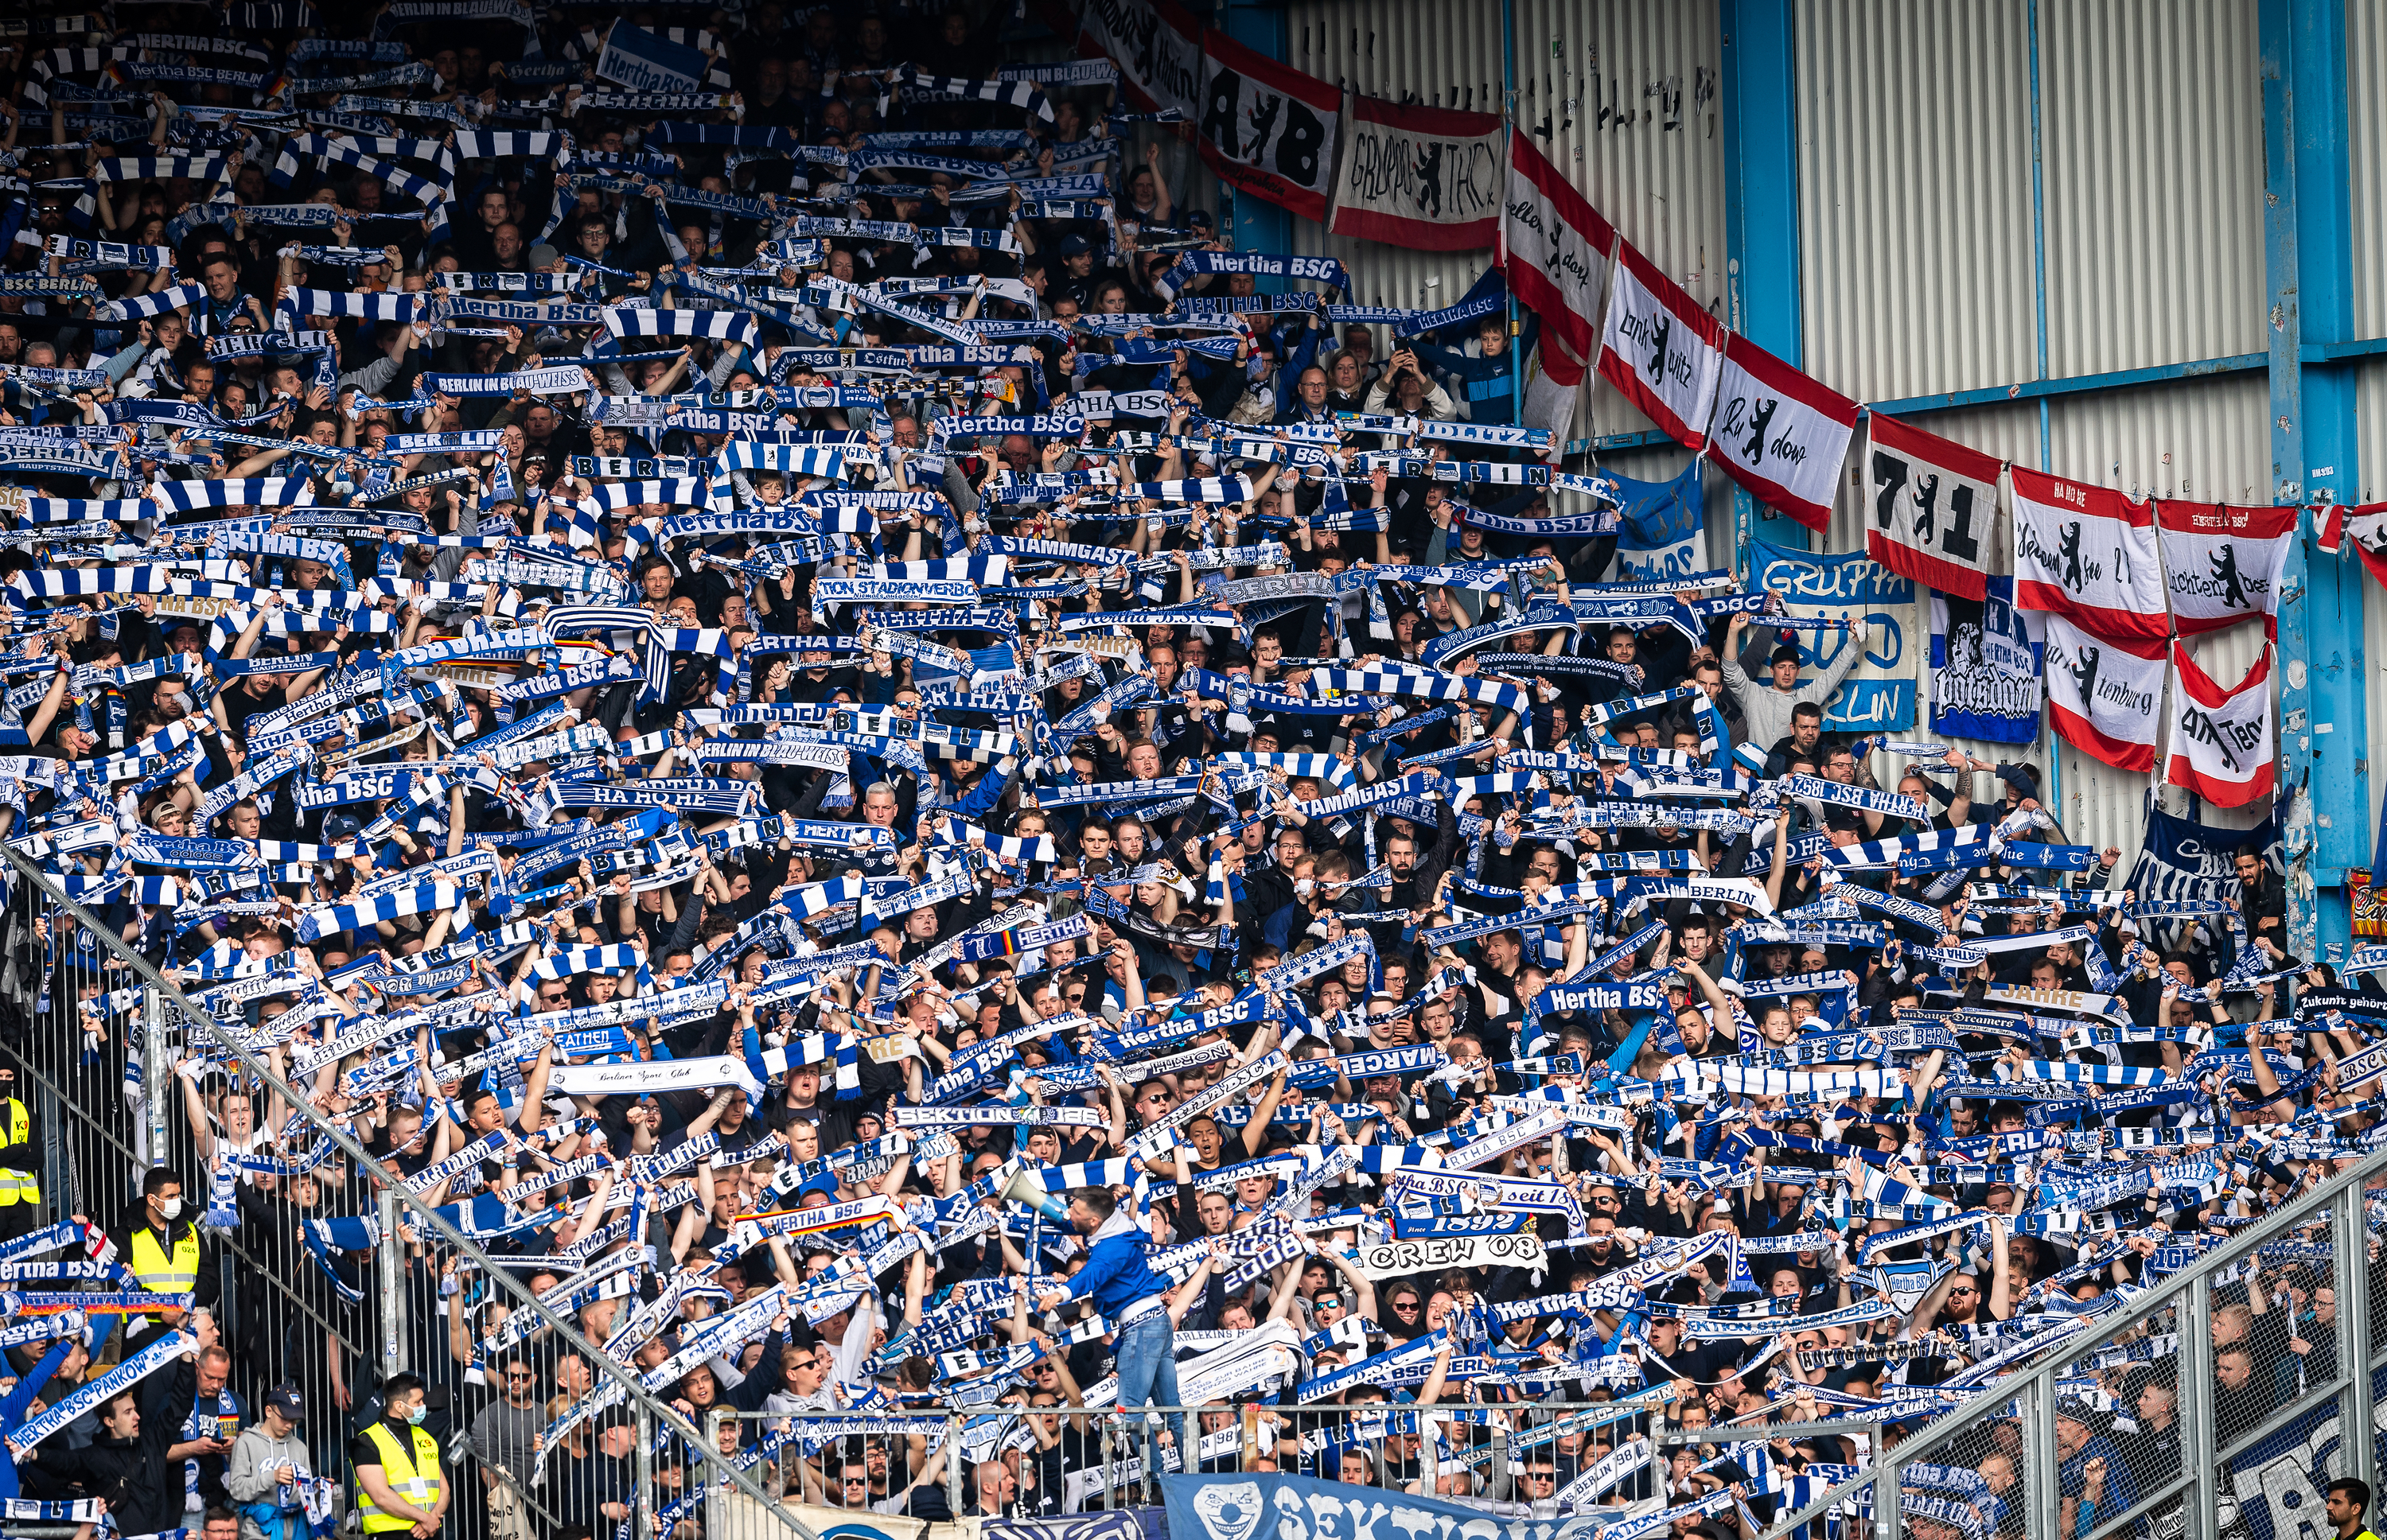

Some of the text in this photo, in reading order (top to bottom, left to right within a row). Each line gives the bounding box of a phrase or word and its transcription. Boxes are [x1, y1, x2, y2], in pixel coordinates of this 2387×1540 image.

[137, 33, 247, 56] HERTHA BSC
[131, 61, 264, 85] Hertha BSC BERLIN
[604, 93, 715, 110] STEGLITZ
[1209, 254, 1335, 279] Hertha BSC
[5, 278, 98, 292] BSC BERLIN
[450, 296, 601, 321] Hertha BSC
[1177, 292, 1318, 314] HERTHA BSC
[1419, 298, 1494, 329] HERTHA BSC
[899, 304, 980, 345] AUS BERLIN
[964, 344, 1008, 363] BSC
[1668, 348, 1692, 389] witz
[438, 370, 579, 392] BERLIN IN BLAU-WEISS
[76, 426, 130, 441] BERLIN
[727, 413, 769, 431] BSC
[944, 416, 1084, 435] Hertha BSC
[18, 463, 81, 472] HAUPTSTADT
[2054, 482, 2085, 508] HA HO HE
[386, 513, 422, 530] Berlin
[300, 538, 346, 568] BSC
[1003, 535, 1137, 569] STAMMGAST
[512, 561, 574, 584] WIEDER
[1445, 567, 1497, 585] BSC
[1762, 559, 1906, 597] GRUPPA
[192, 597, 232, 617] BSC
[1080, 610, 1215, 626] Hertha B.S.C.
[1641, 601, 1667, 614] SÜD
[1436, 604, 1556, 651] GRUPPA SÜD
[1986, 641, 2030, 674] HERTHA BSC
[425, 663, 498, 686] JAHRE
[495, 659, 605, 702] Hertha BSC
[286, 683, 365, 725] Hertha BSC
[299, 717, 338, 741] BSC
[697, 741, 845, 766] BERLIN IN BLAU-WEISS
[345, 774, 394, 799] BSC
[594, 788, 708, 807] HA HO HE
[1057, 777, 1169, 798] BERLIN
[1794, 774, 1827, 797] 1892
[1831, 781, 1865, 804] BSC
[135, 835, 216, 853] Hertha
[475, 830, 504, 846] Hause
[533, 826, 547, 838] wir
[548, 820, 575, 836] nicht
[169, 849, 224, 861] adidas
[1801, 838, 1828, 859] HE
[1690, 886, 1757, 908] BERLIN
[977, 902, 1030, 935] EAST
[1016, 920, 1088, 946] HERTHA
[1552, 987, 1622, 1012] Hertha
[2000, 984, 2086, 1009] JAHRE
[2302, 994, 2349, 1012] Zukunft
[1203, 998, 1250, 1032] BSC
[1952, 1010, 2015, 1029] Dreamers
[1119, 1016, 1200, 1051] Hertha
[1879, 1032, 1912, 1052] BSC
[978, 1043, 1015, 1075] BSC
[1799, 1036, 1855, 1062] BSC
[1151, 1045, 1230, 1078] NORTH
[2342, 1052, 2381, 1082] BSC
[596, 1068, 693, 1084] Berliner Sport Club
[1220, 1060, 1266, 1092] BSC
[1565, 1102, 1602, 1122] AUS
[2099, 1093, 2155, 1113] BERLIN
[895, 1106, 1012, 1126] SEKTION
[1497, 1125, 1528, 1151] BSC
[447, 1139, 493, 1172] CURVA
[657, 1130, 716, 1176] CURVA
[1229, 1155, 1281, 1180] B.S.C.
[1508, 1190, 1543, 1205] seit
[771, 1204, 863, 1232] HERTHA BSC
[1431, 1212, 1518, 1234] 1892
[1924, 1215, 1965, 1235] Sport
[181, 1246, 197, 1255] 024
[1368, 1238, 1477, 1271] CREW
[1224, 1234, 1303, 1293] 2008
[1618, 1258, 1656, 1286] BSC
[1890, 1275, 1932, 1291] Hertha BSC
[25, 1296, 123, 1306] HERTHA
[127, 1295, 175, 1305] BSC
[1497, 1284, 1638, 1325] Hertha BSC
[913, 1320, 994, 1357] BERLIN
[1347, 1350, 1414, 1385] B.S.C.
[10, 1353, 150, 1449] HERTHA BSC PANKOW
[417, 1438, 433, 1449] K9
[1571, 1458, 1613, 1496] BERLIN
